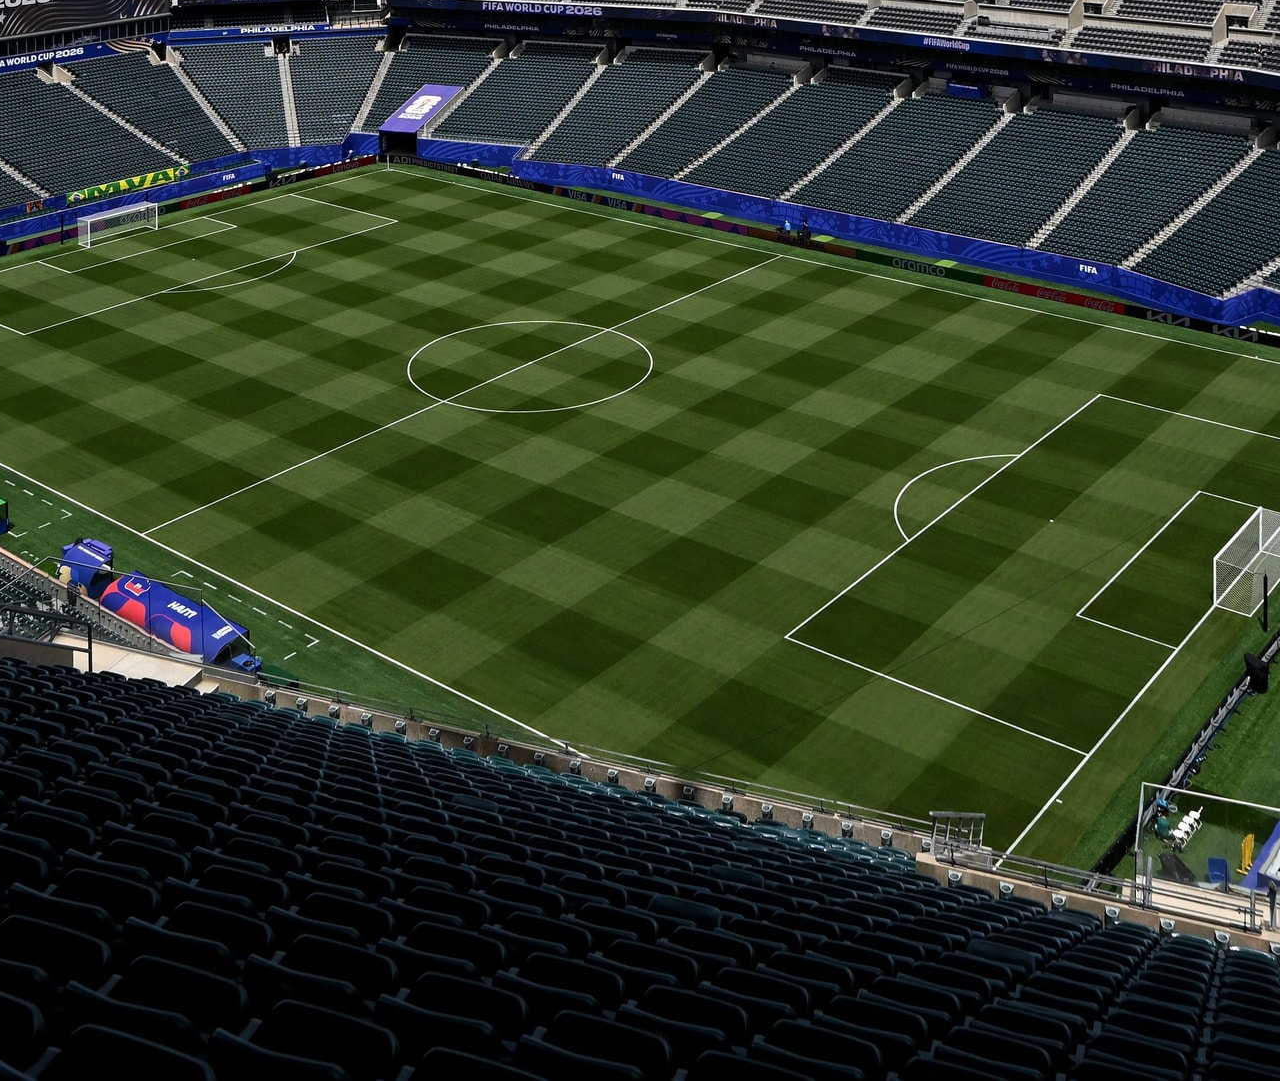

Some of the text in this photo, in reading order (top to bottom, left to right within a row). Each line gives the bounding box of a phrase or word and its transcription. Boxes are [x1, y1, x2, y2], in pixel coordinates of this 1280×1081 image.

[483, 2, 602, 15] FIFA WORLD CUP 2026
[712, 13, 777, 29] HILADPHIA
[241, 25, 315, 34] PHILADELPHIA
[923, 38, 970, 51] #FIFAWorldCup
[7, 55, 36, 66] WORLD
[38, 52, 54, 61] CUP
[56, 48, 83, 58] 2026
[800, 46, 856, 58] PHILADELPHIA
[1146, 61, 1244, 81] PHILADPHIA
[1111, 83, 1184, 97] PHILADELPHIA
[393, 156, 411, 164] ADI
[333, 160, 360, 173] Lenovo
[222, 173, 235, 182] FIFA
[480, 172, 504, 183] QATAR
[612, 173, 624, 181] FIFA
[568, 190, 587, 201] VISA
[608, 198, 627, 210] VISA
[892, 257, 945, 277] aramco
[1079, 264, 1097, 274] FIFA
[167, 601, 198, 618] HAITI
